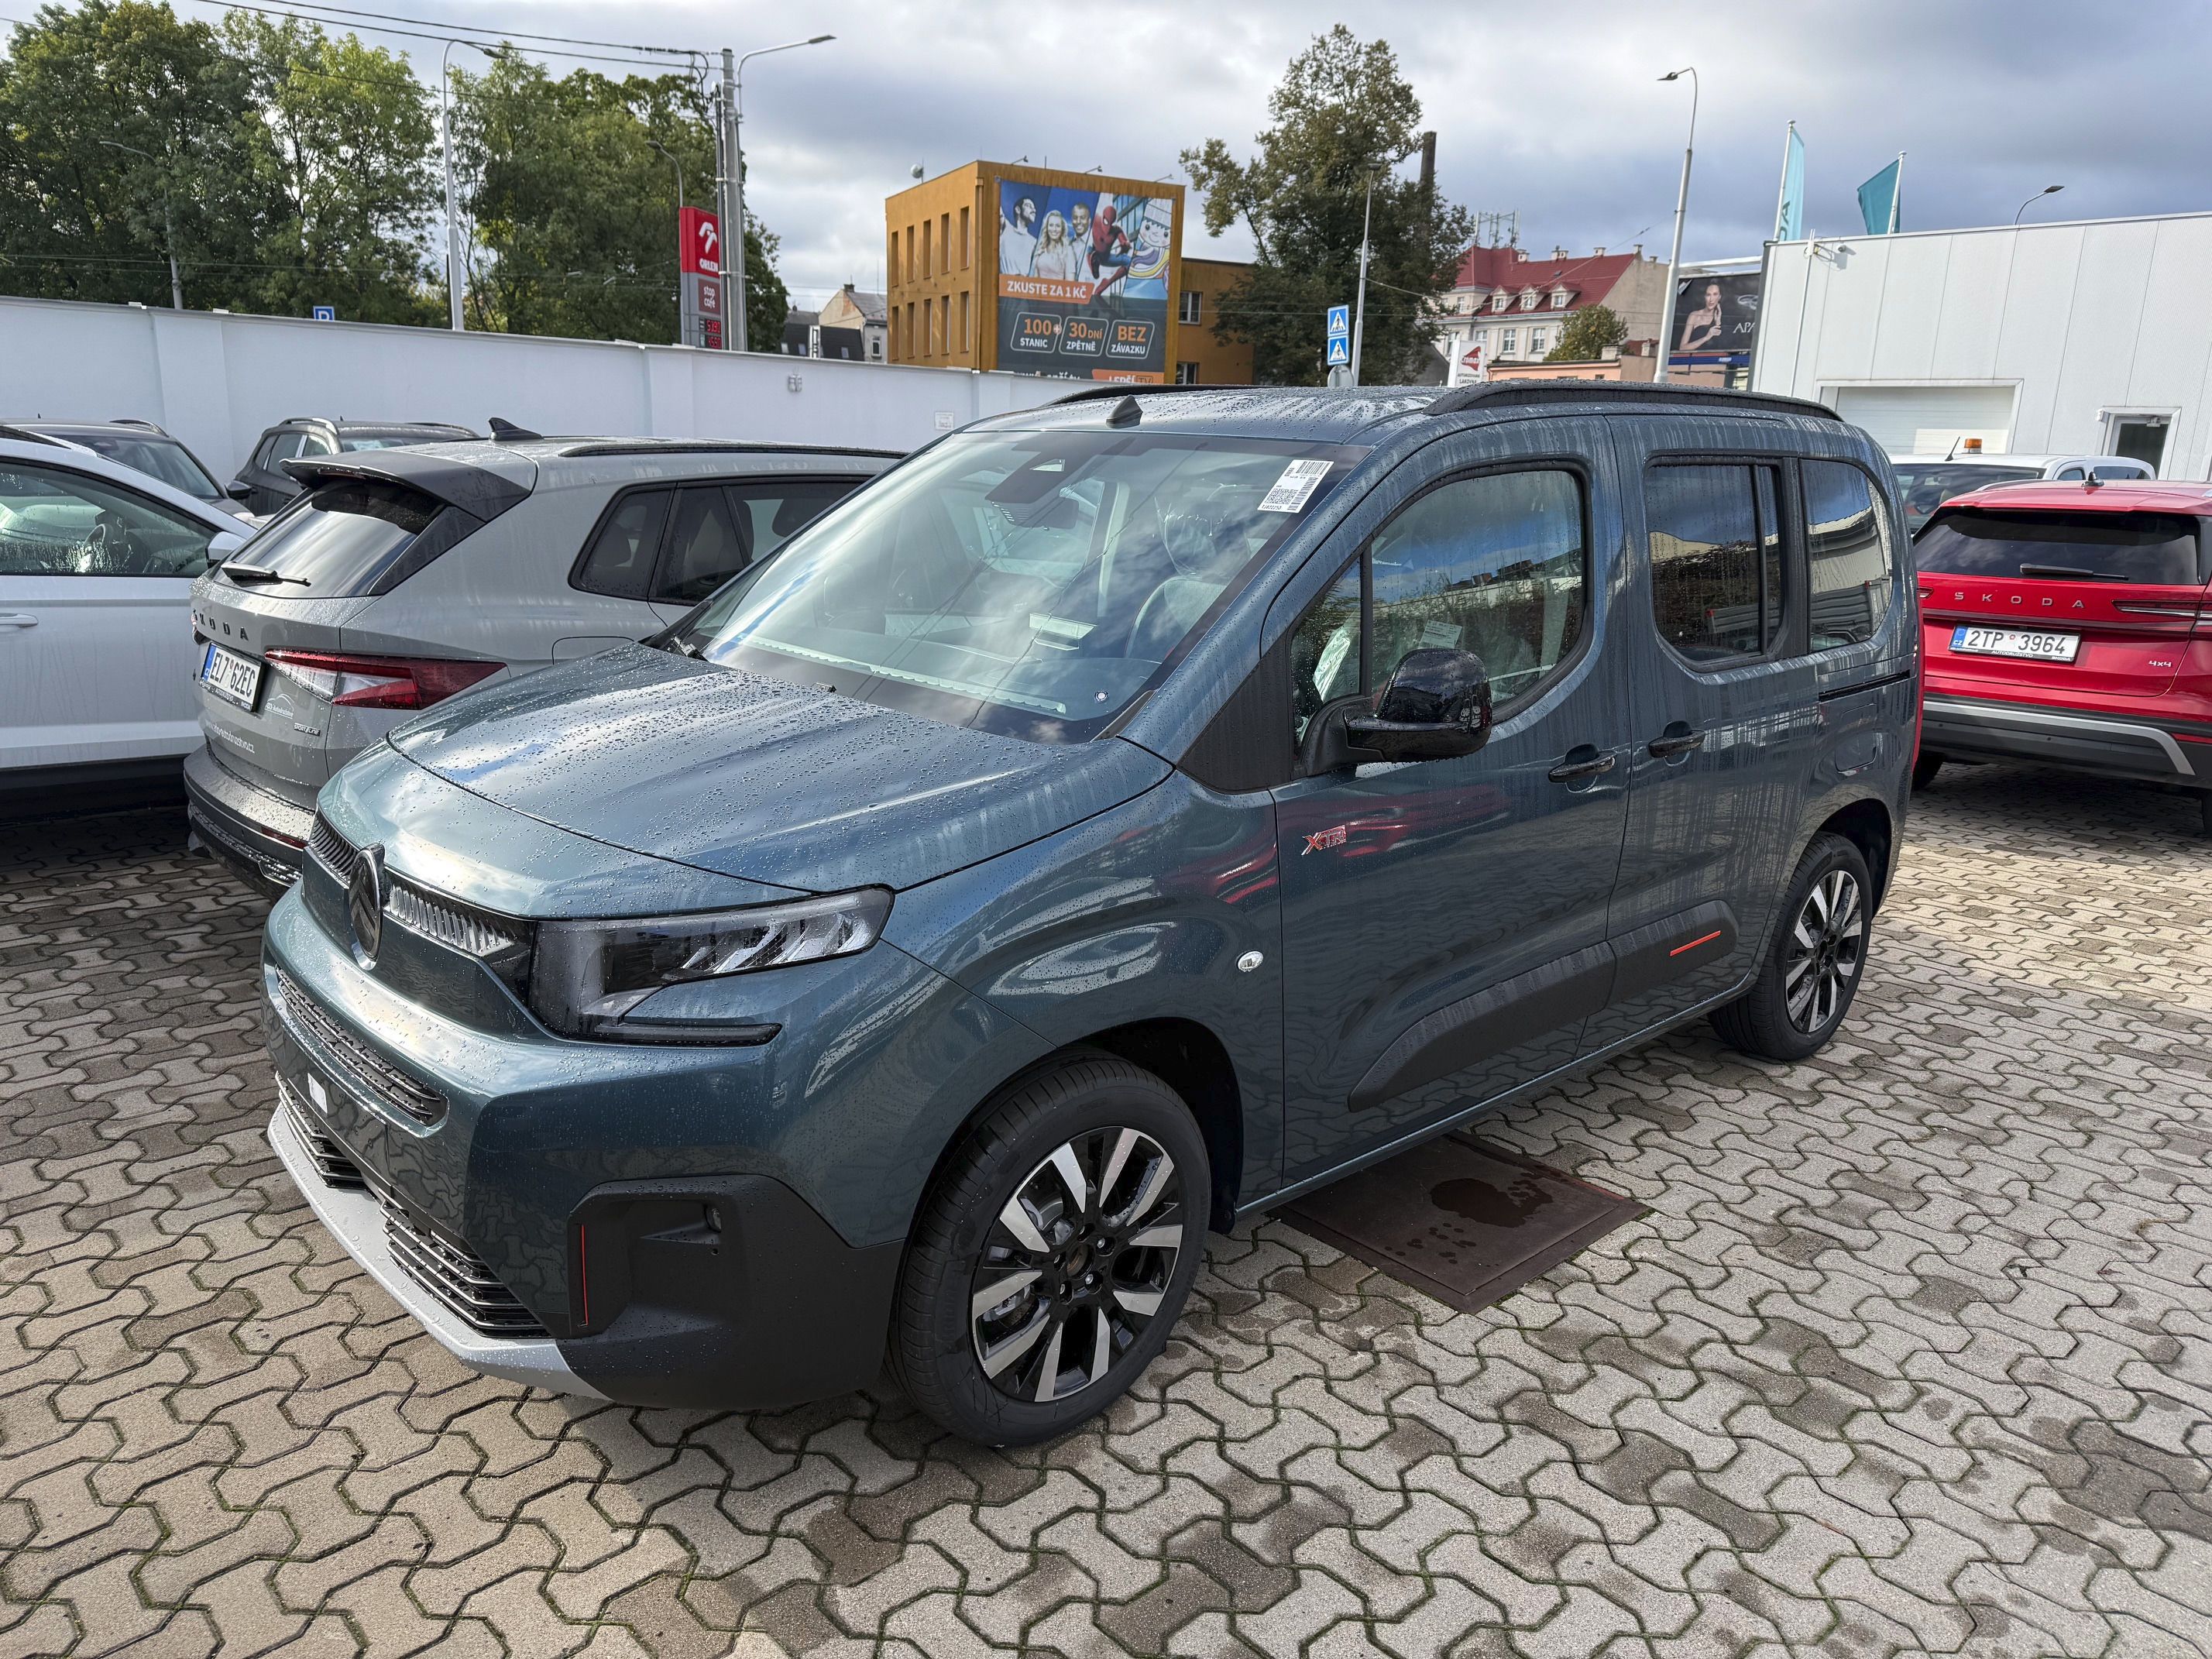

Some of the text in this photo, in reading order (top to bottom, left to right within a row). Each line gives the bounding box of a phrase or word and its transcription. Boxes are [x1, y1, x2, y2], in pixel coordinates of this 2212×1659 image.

[699, 258, 719, 273] ORLEN
[703, 285, 716, 297] stop
[1007, 280, 1087, 299] ZKUSTE ZA 1 KČ
[1069, 322, 1103, 339] 30 DNÍ
[1117, 325, 1146, 342] BEZ
[1020, 338, 1048, 348] STANIC
[1066, 341, 1096, 352] ZPĚTNĚ
[1111, 344, 1146, 355] ZÁVAZKU
[1967, 630, 2004, 648] 2TP
[2018, 634, 2066, 654] 3964
[210, 652, 230, 683] EL7
[231, 661, 256, 698] 62EC
[1300, 824, 1347, 856] XTR
